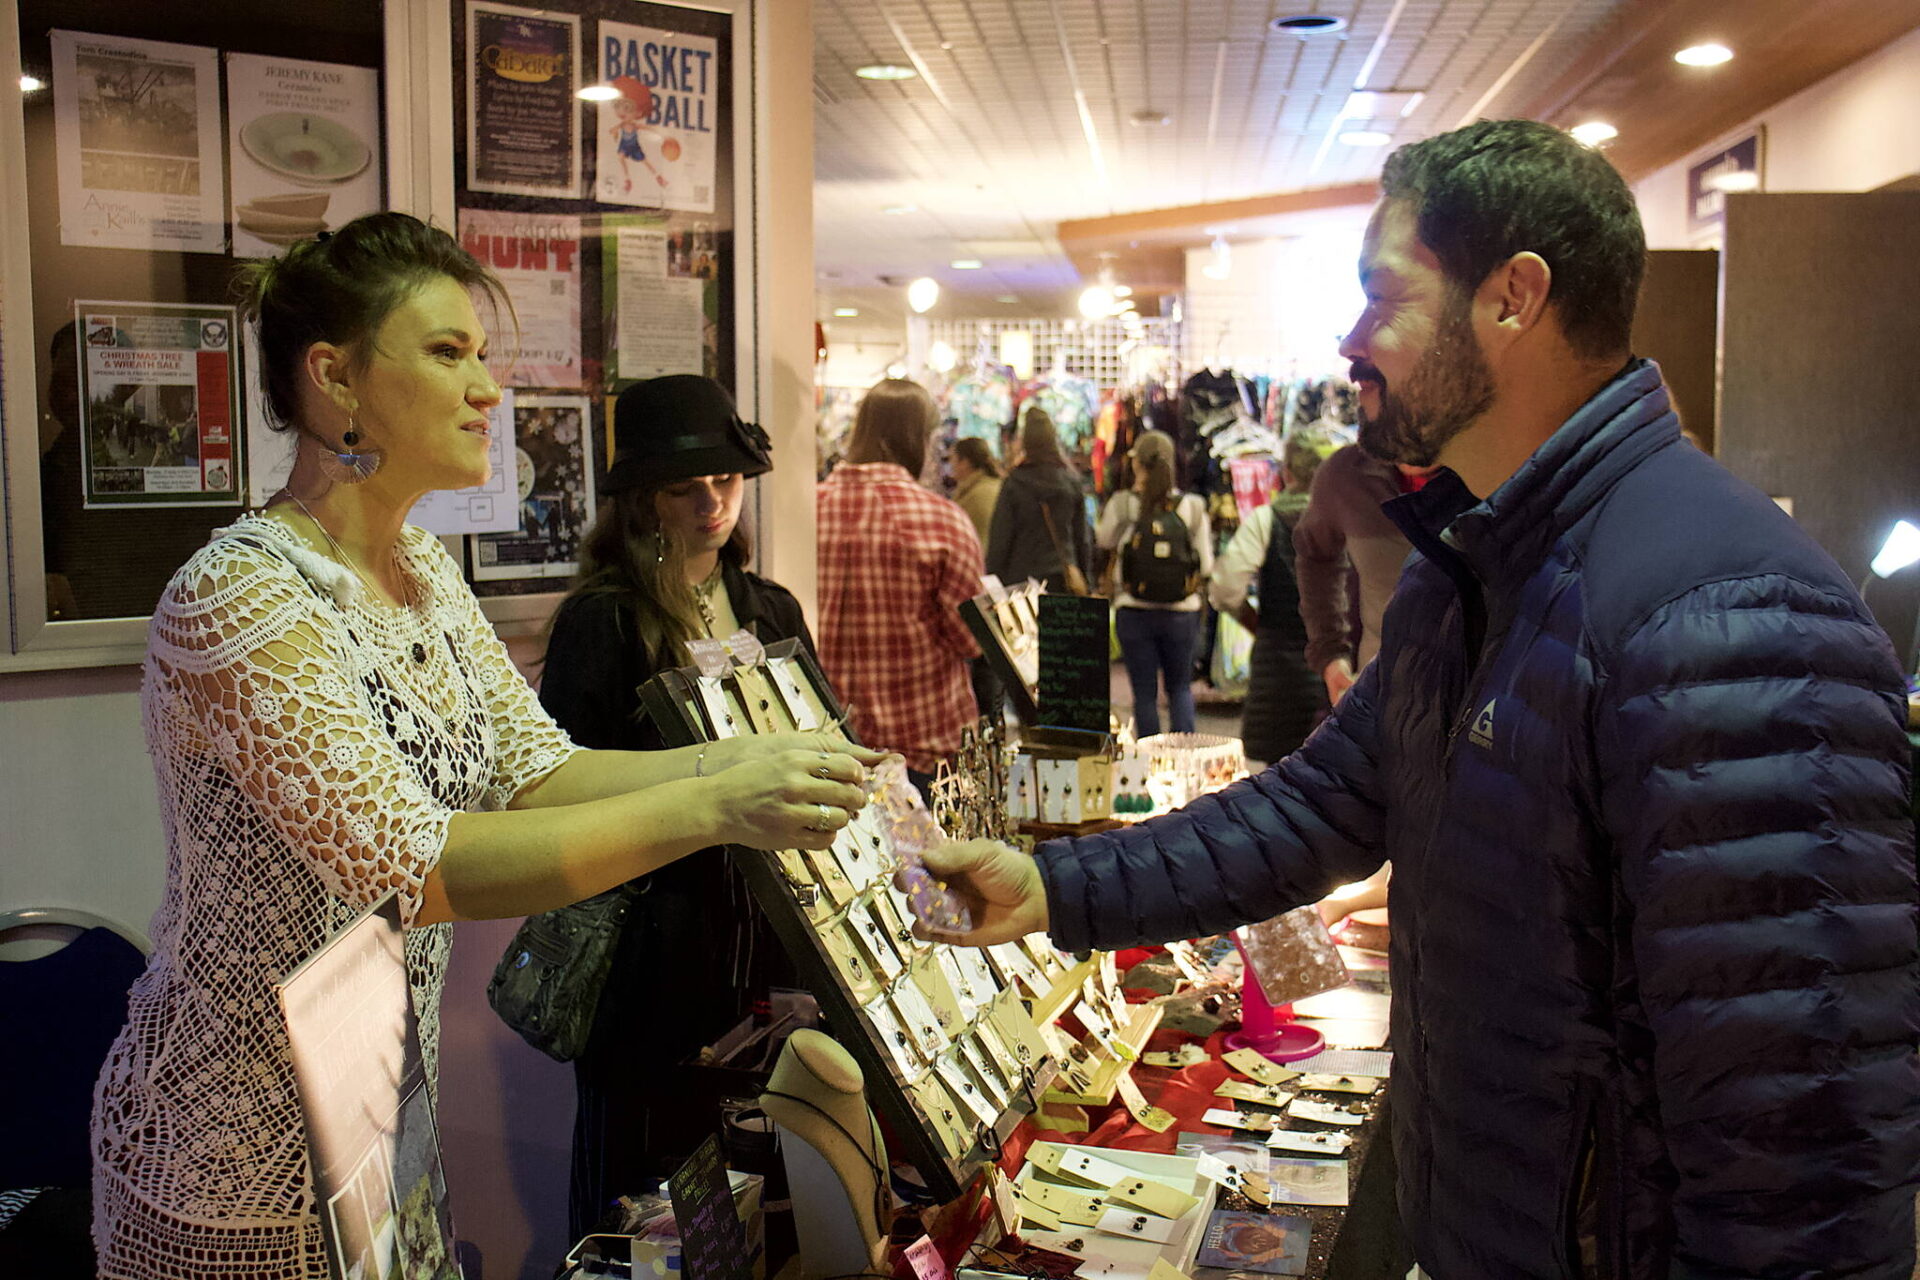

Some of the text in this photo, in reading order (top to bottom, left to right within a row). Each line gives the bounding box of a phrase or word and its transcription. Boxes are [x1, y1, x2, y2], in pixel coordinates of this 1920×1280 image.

[605, 36, 712, 95] BASKET
[646, 93, 711, 133] BALL
[463, 233, 577, 272] HUNT
[100, 351, 184, 361] CHRISTMAS TREE
[114, 360, 154, 369] WREATH
[157, 361, 181, 369] SALE
[1207, 1224, 1225, 1249] HELLO
